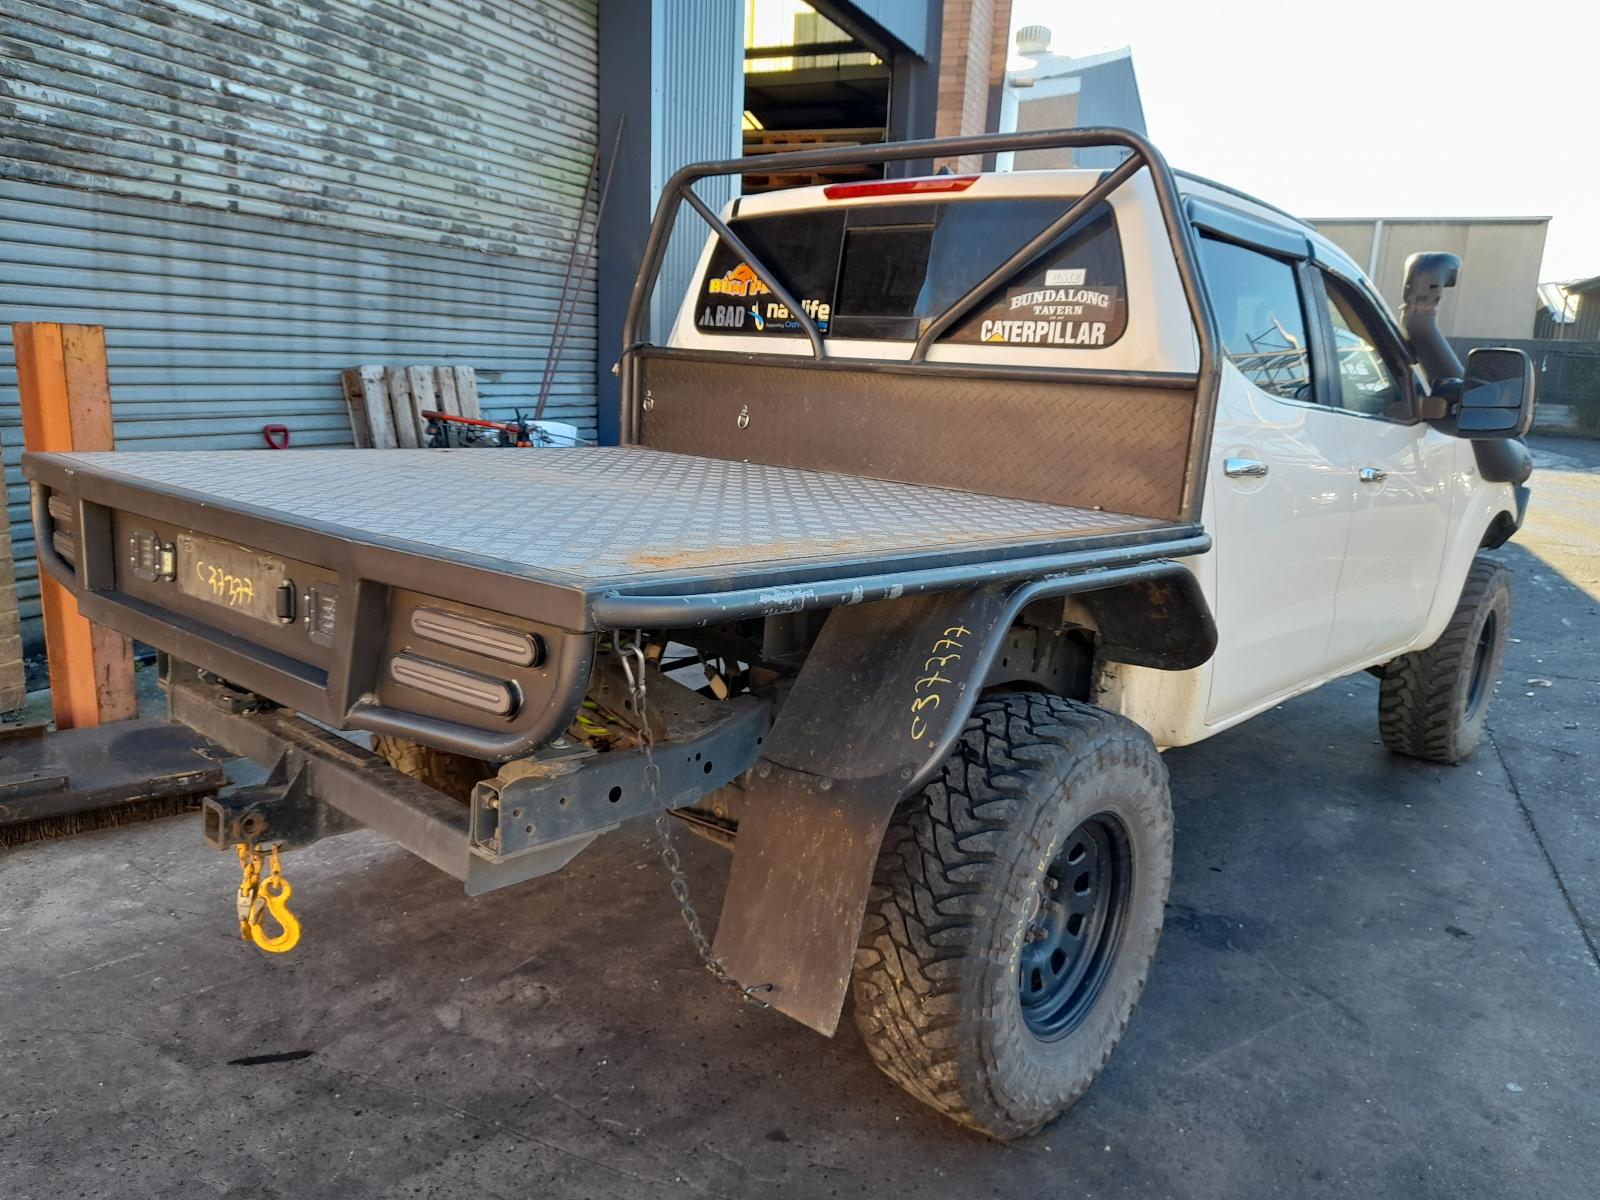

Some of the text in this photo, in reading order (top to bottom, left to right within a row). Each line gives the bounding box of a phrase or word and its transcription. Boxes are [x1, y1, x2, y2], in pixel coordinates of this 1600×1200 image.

[767, 299, 829, 320] nalife
[1010, 289, 1110, 310] BUNDALONG
[1033, 305, 1084, 315] TAVERN
[715, 306, 745, 327] BAD
[980, 320, 1107, 345] CATERPILLAR
